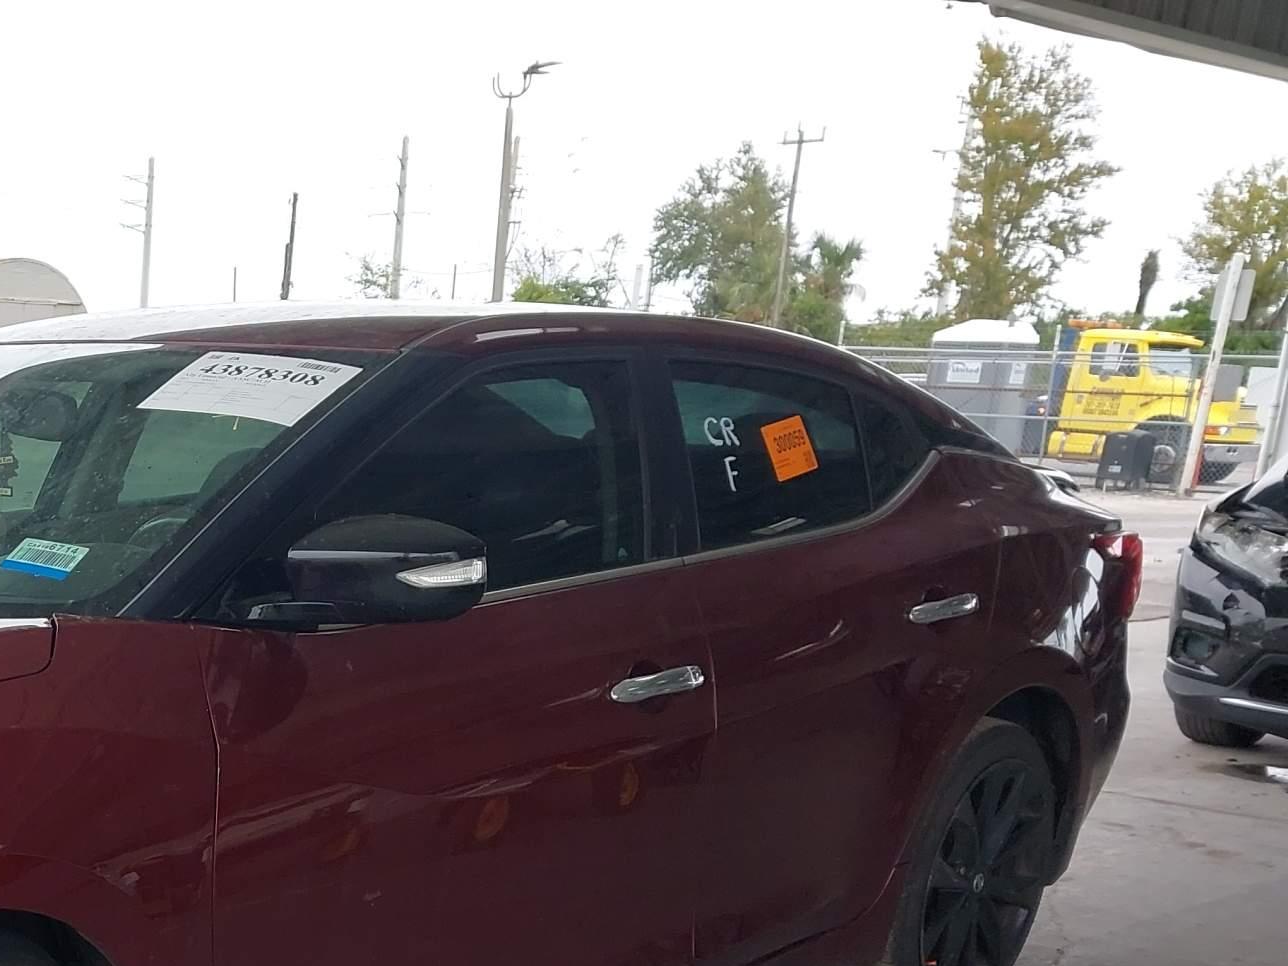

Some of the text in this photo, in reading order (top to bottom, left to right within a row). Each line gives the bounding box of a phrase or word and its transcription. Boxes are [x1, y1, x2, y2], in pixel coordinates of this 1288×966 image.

[200, 363, 326, 386] 43878308
[703, 416, 740, 446] CR
[723, 455, 738, 492] F
